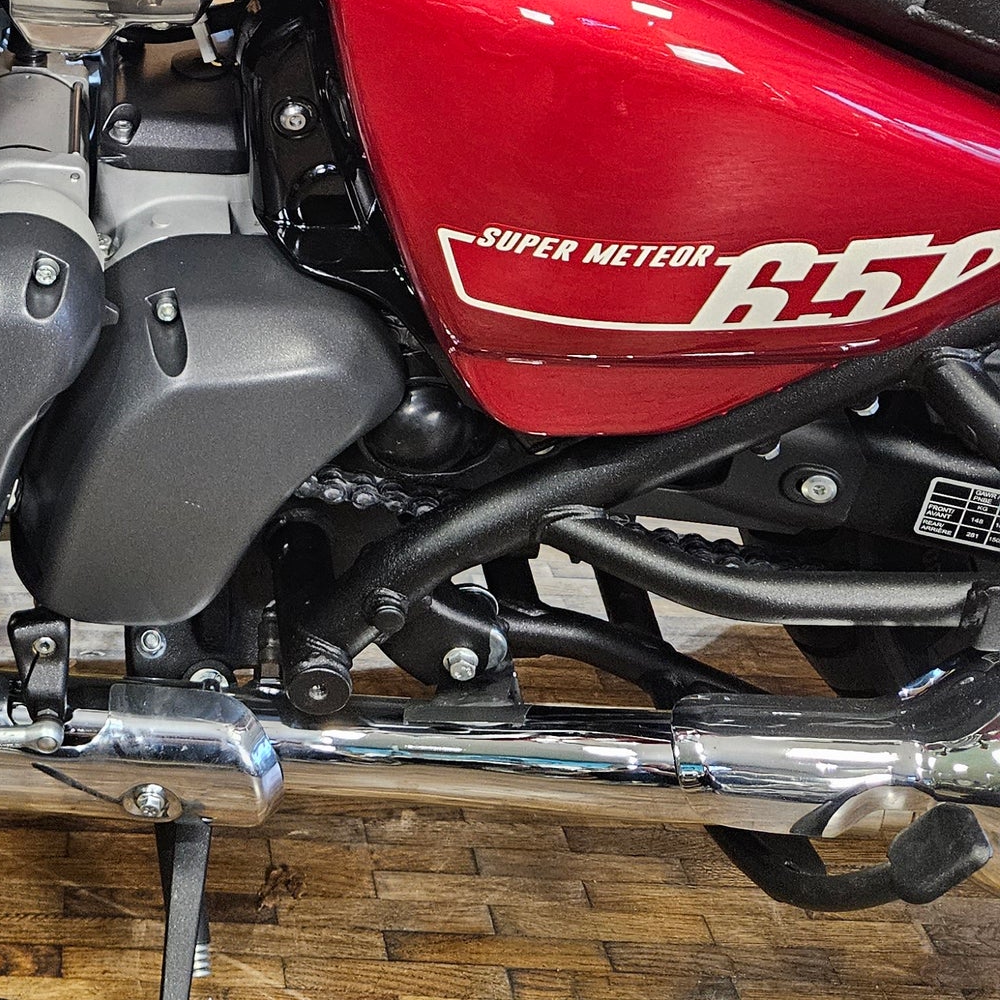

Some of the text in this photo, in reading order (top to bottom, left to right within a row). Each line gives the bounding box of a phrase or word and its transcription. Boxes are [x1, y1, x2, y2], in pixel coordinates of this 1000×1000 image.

[477, 227, 575, 262] SUPER
[583, 242, 716, 268] METEOR
[975, 490, 997, 499] GAWR
[928, 504, 955, 514] FRONT/
[926, 510, 952, 519] AVANT
[922, 519, 945, 527] REAR/
